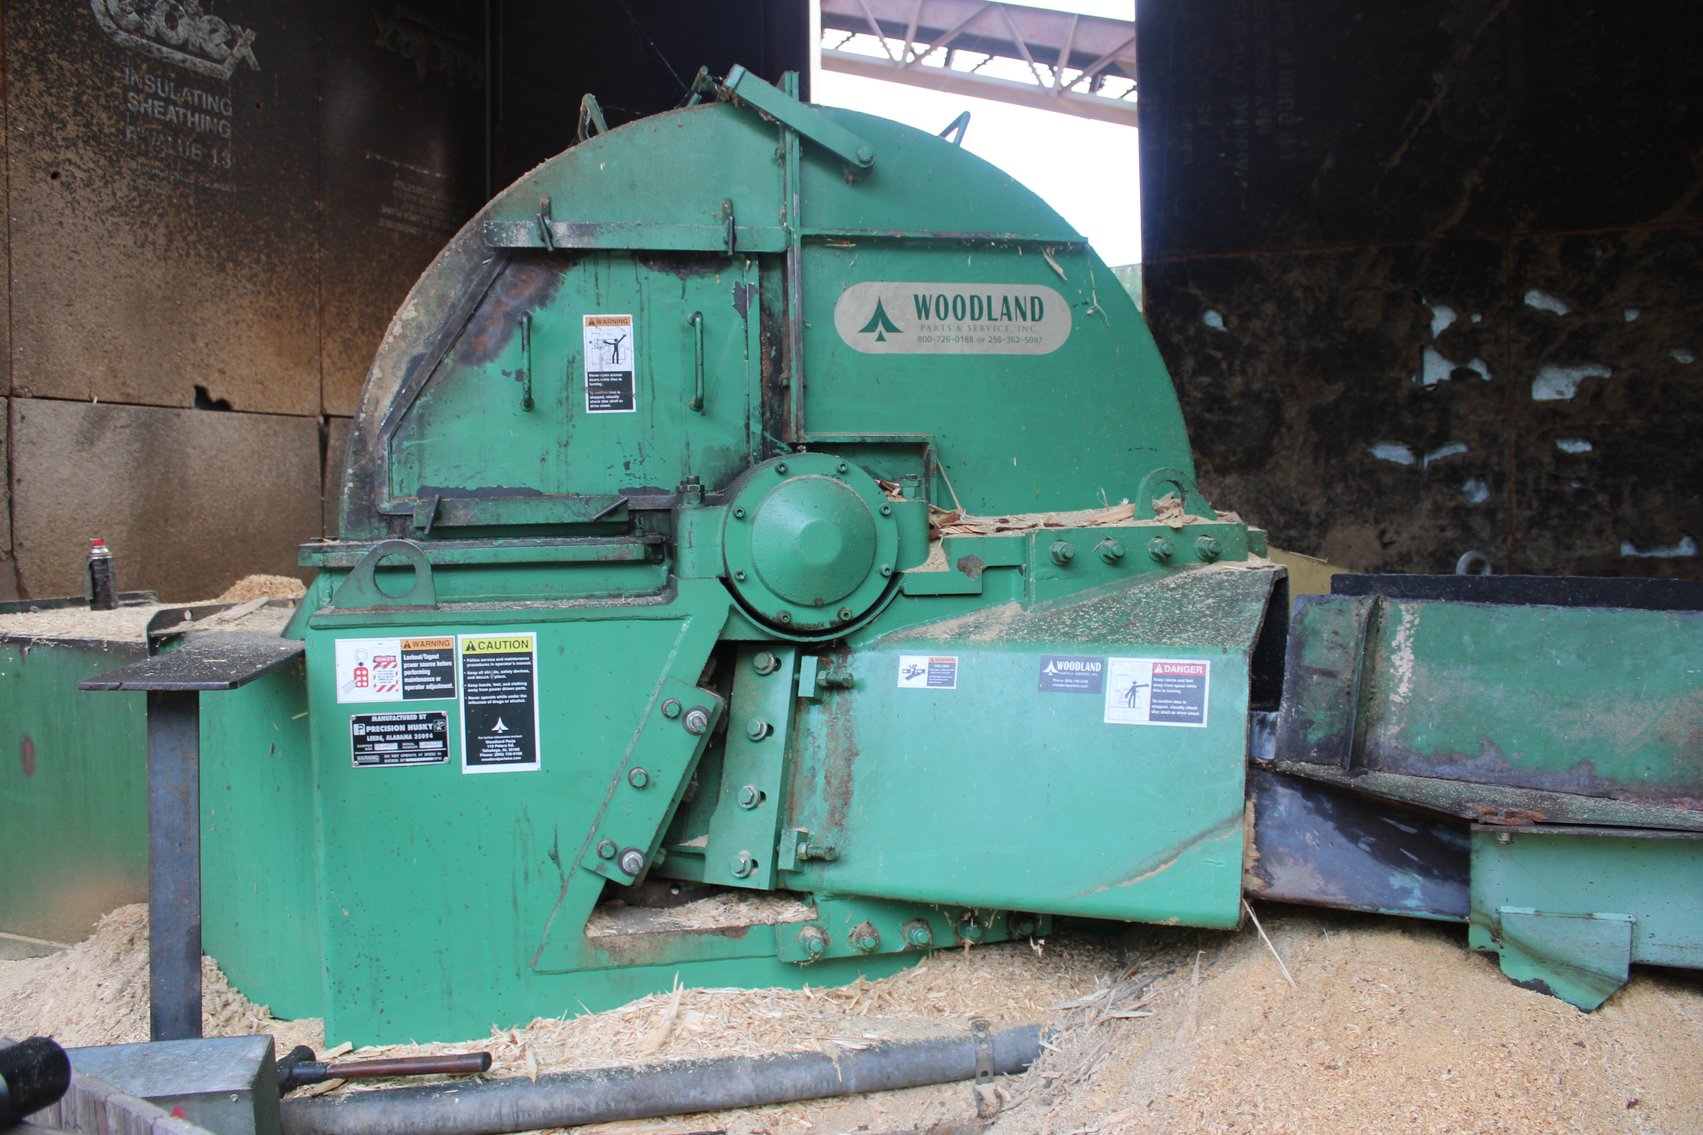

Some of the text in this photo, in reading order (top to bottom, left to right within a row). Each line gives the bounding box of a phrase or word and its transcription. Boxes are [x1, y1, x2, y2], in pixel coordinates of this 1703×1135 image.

[124, 67, 232, 116] INSULATING
[127, 92, 231, 138] SHEATHING
[914, 294, 1044, 321] WOODLAND
[478, 640, 528, 650] CAUTION
[1057, 661, 1101, 672] WOODLAND
[1164, 665, 1203, 673] DANGER
